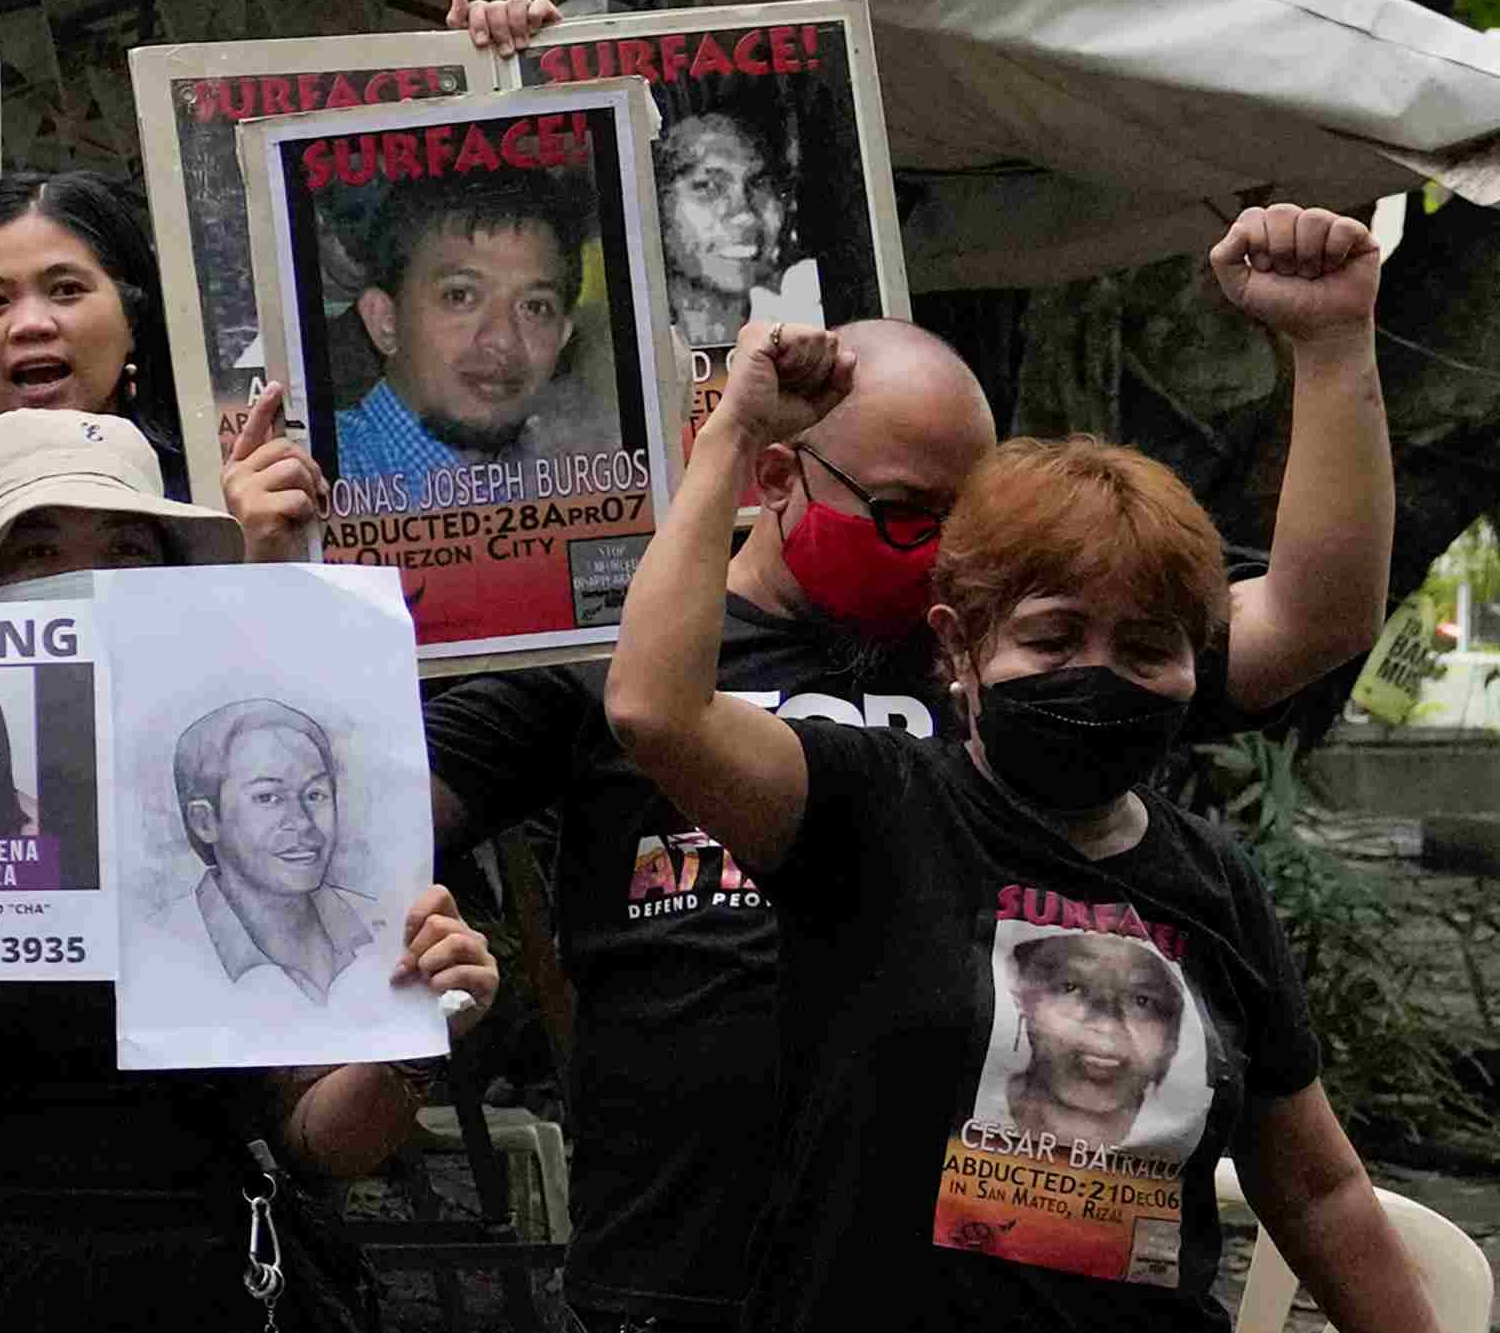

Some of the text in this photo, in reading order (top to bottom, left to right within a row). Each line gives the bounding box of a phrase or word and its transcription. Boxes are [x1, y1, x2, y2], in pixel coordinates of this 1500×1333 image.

[539, 24, 821, 85] SURFACE!
[193, 67, 444, 122] SURFACE!
[302, 112, 592, 193] SURFACE!
[419, 448, 650, 510] JOSEPH BURGOS
[627, 893, 699, 919] DEFEND
[960, 1116, 1058, 1164] CESAR
